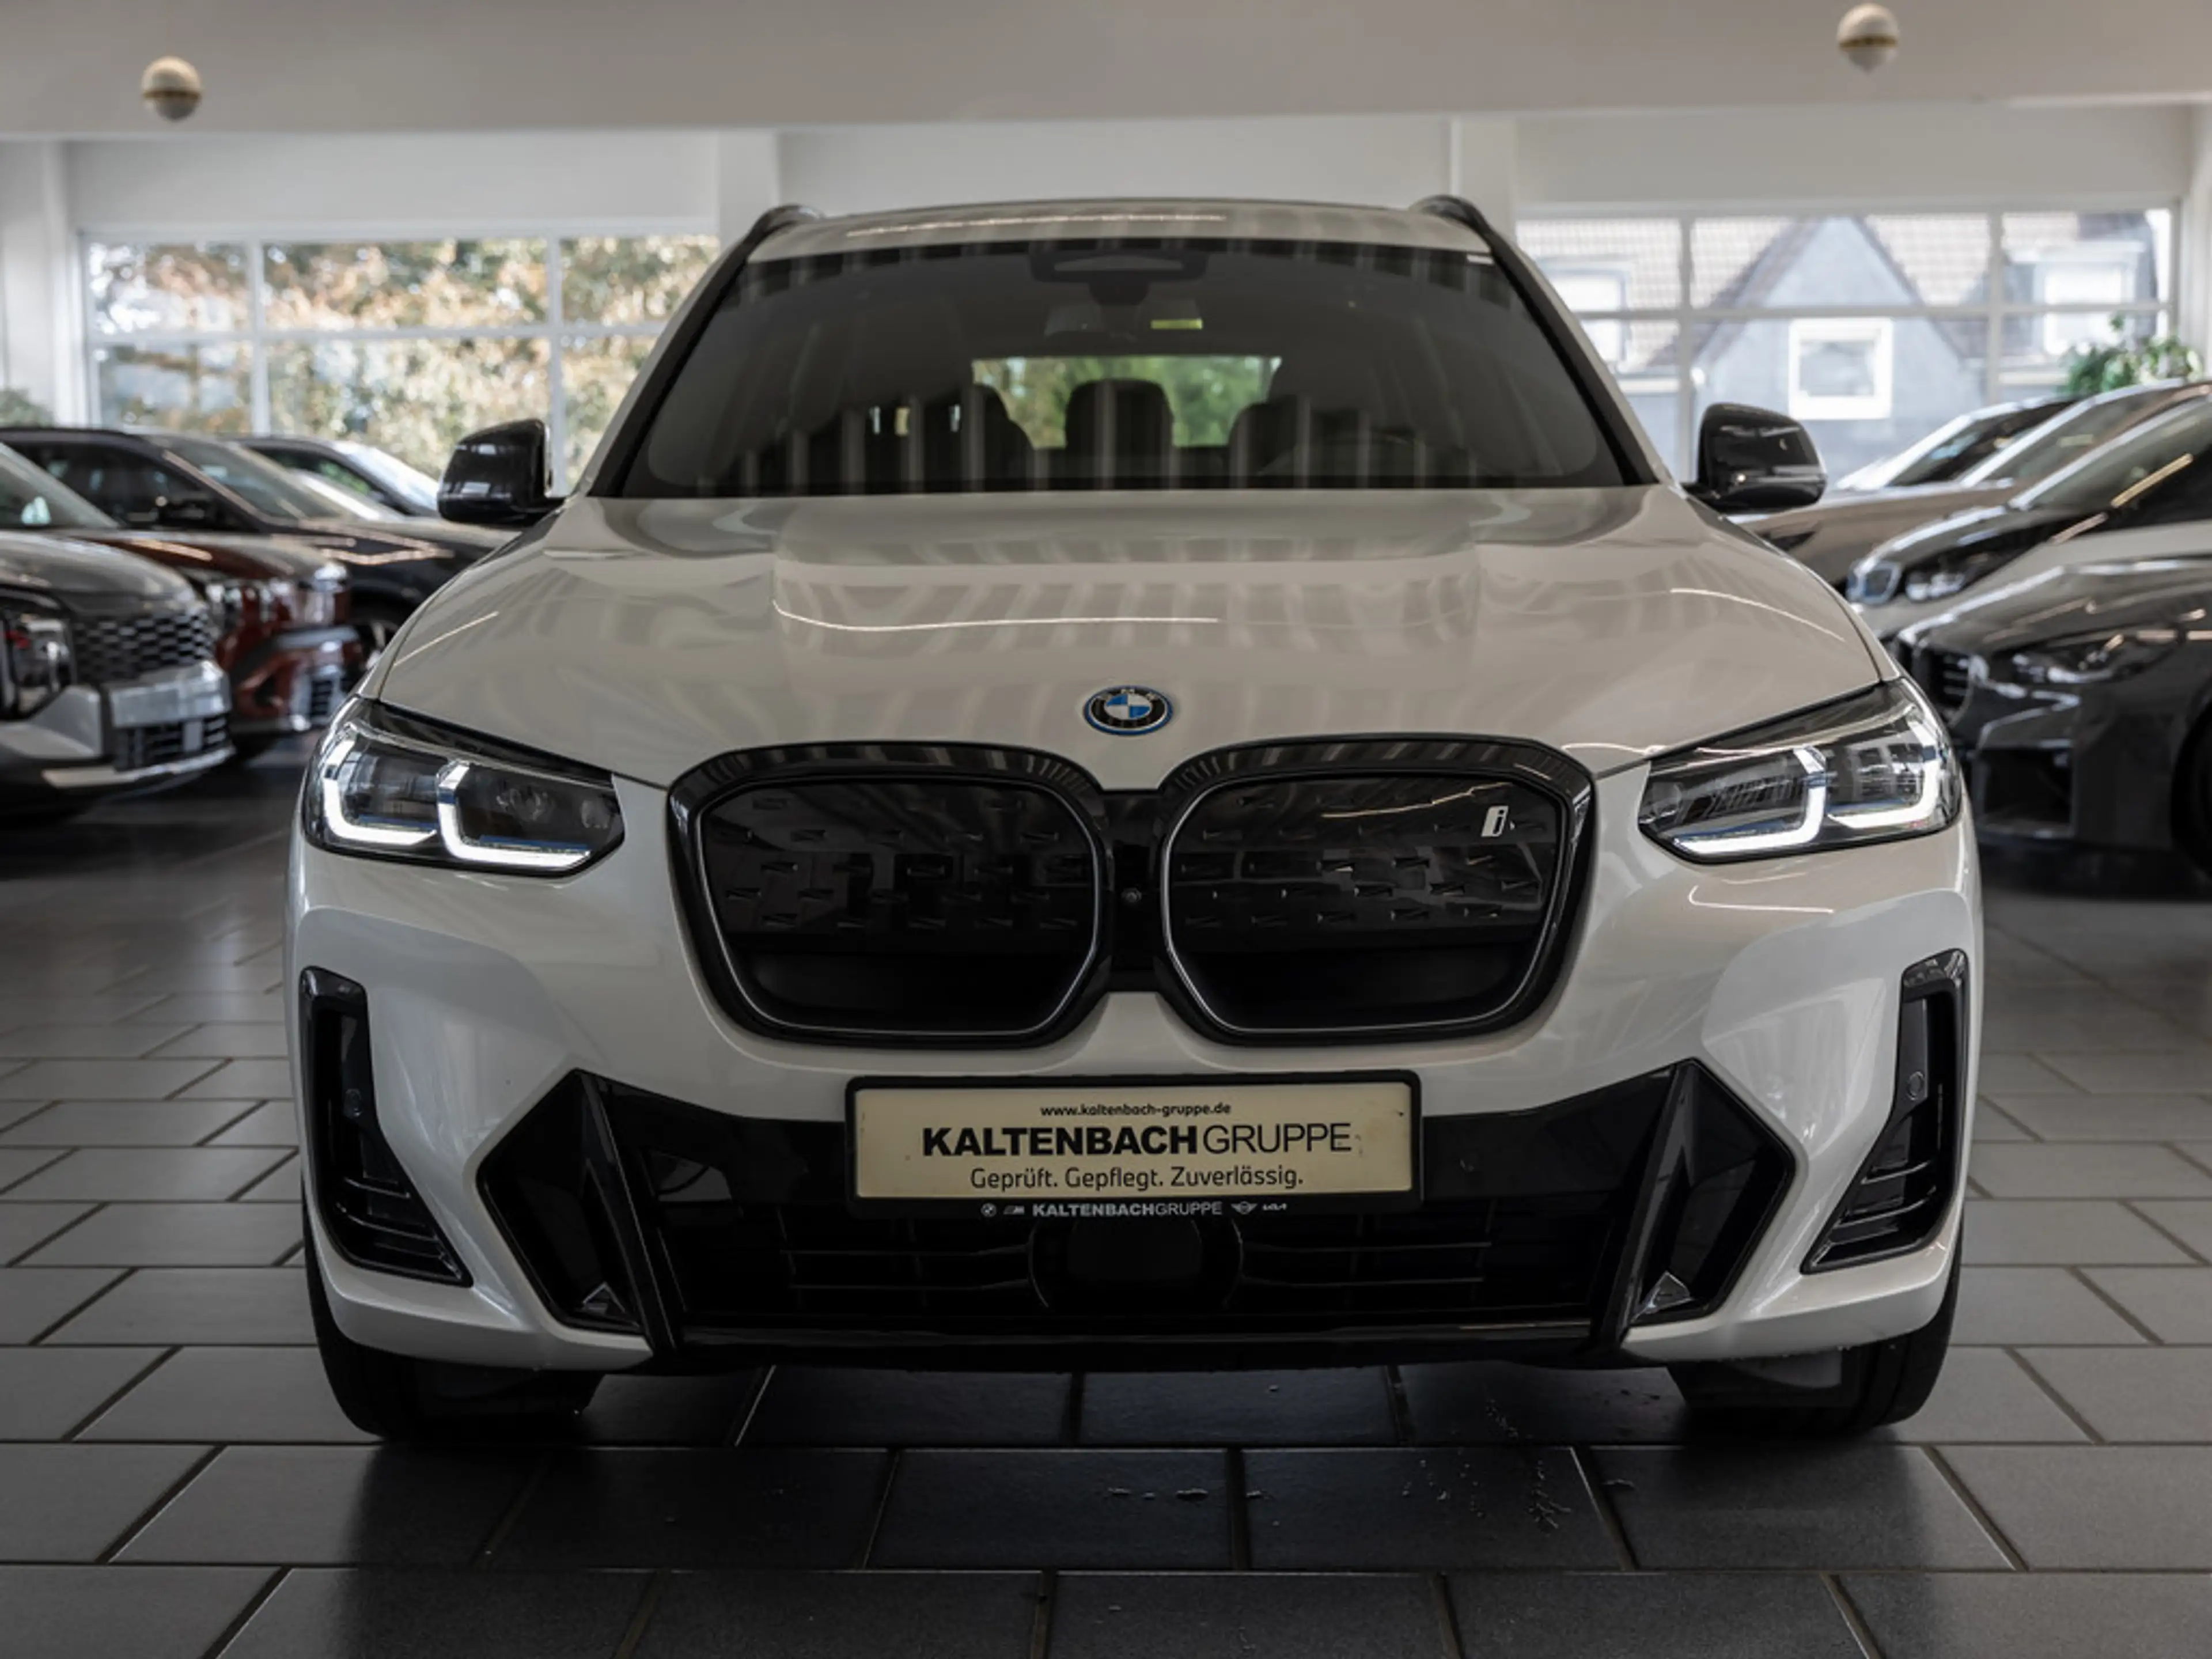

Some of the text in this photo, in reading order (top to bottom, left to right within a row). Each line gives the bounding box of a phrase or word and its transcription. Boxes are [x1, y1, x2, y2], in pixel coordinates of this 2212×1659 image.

[1040, 1102, 1232, 1118] www.kaltenbach-gruppe.de
[970, 1165, 1304, 1192] Geprüft. Gepflegt. Zuverlässig.
